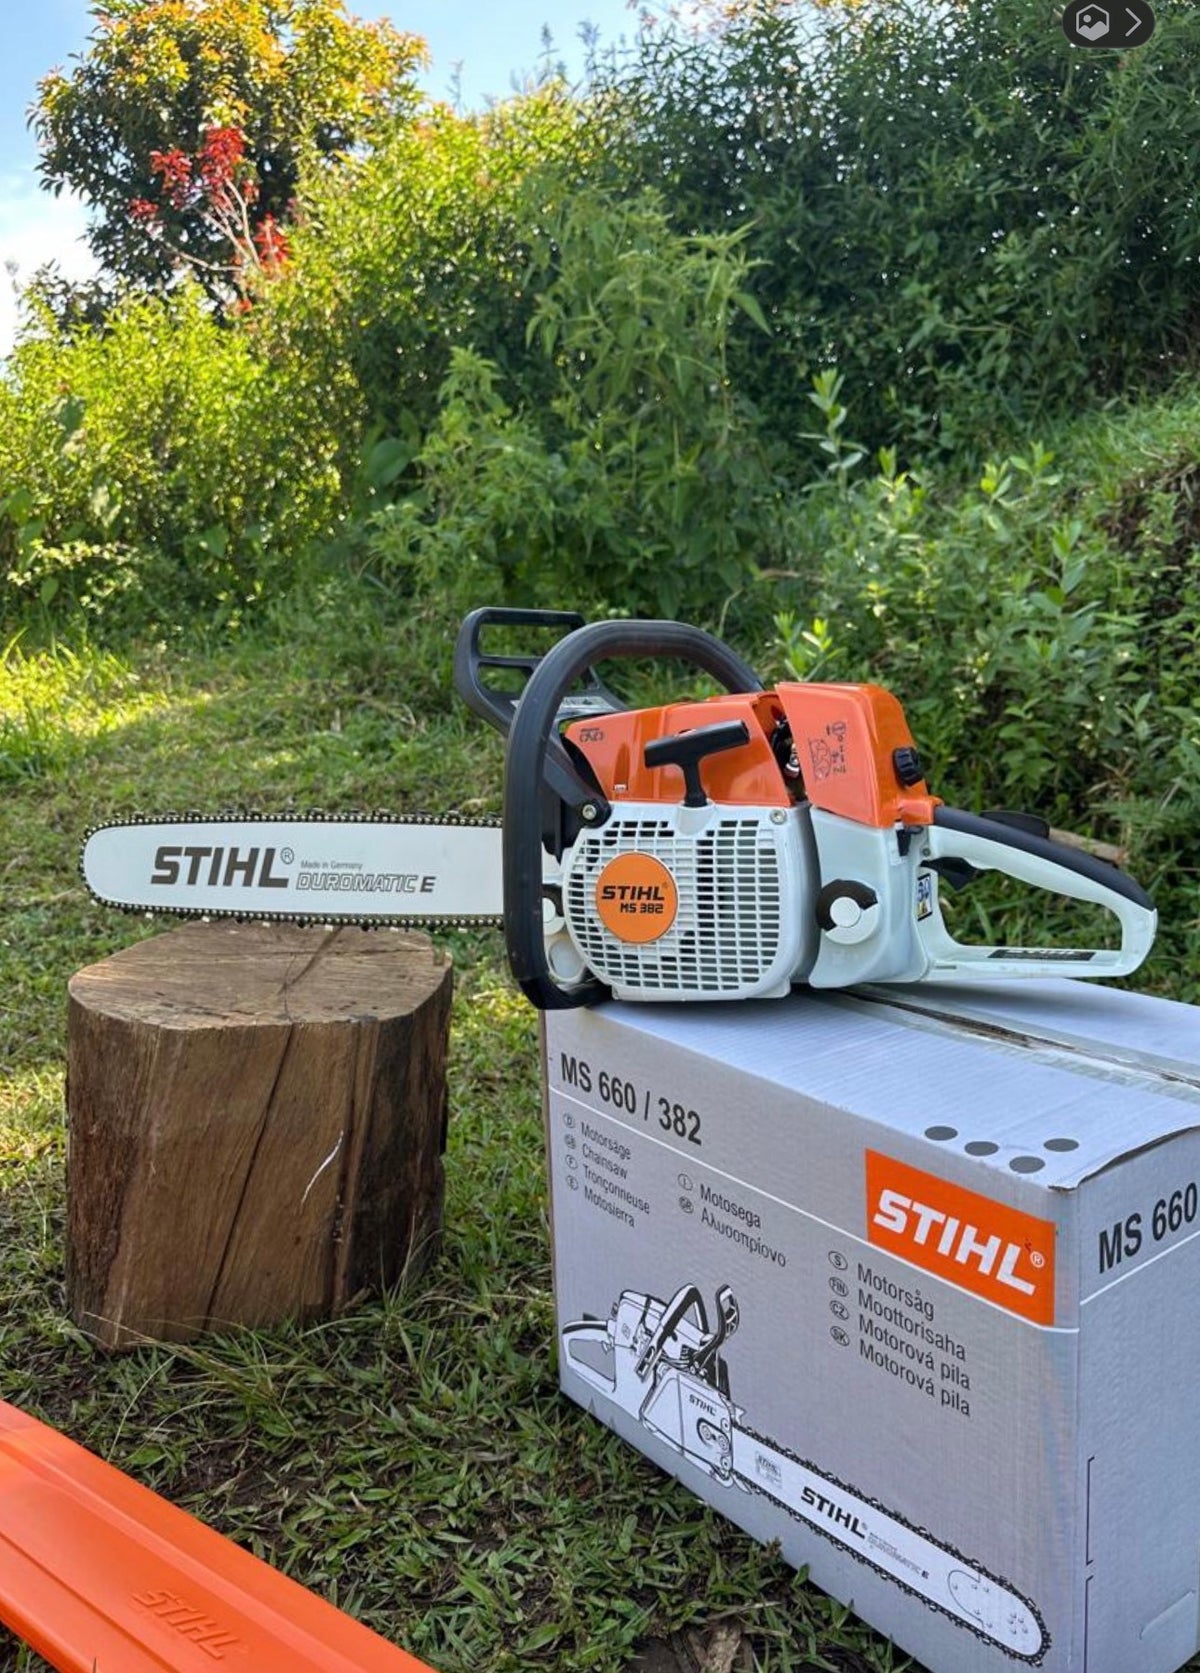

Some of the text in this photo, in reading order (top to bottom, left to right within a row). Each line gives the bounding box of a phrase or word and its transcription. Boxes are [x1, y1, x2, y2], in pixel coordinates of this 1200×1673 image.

[296, 871, 437, 894] DUROMATIC E
[300, 860, 320, 869] Made
[330, 860, 363, 871] Germany
[620, 903, 664, 914] MS 382
[561, 1052, 702, 1146] MS 660 / 382
[582, 1143, 628, 1179] Chainsaw
[583, 1163, 650, 1215] Tronçonneuse
[584, 1185, 635, 1228] Motosierra
[700, 1183, 761, 1228] Motosega
[1099, 1182, 1198, 1274] MS 660
[857, 1262, 934, 1321] Motorsåg
[858, 1288, 966, 1361] Moottorisaha
[859, 1313, 934, 1371] Motorová
[941, 1362, 970, 1390] pila
[860, 1338, 935, 1397] Motorová
[941, 1388, 970, 1417] pila
[131, 1589, 239, 1660] STIHL
